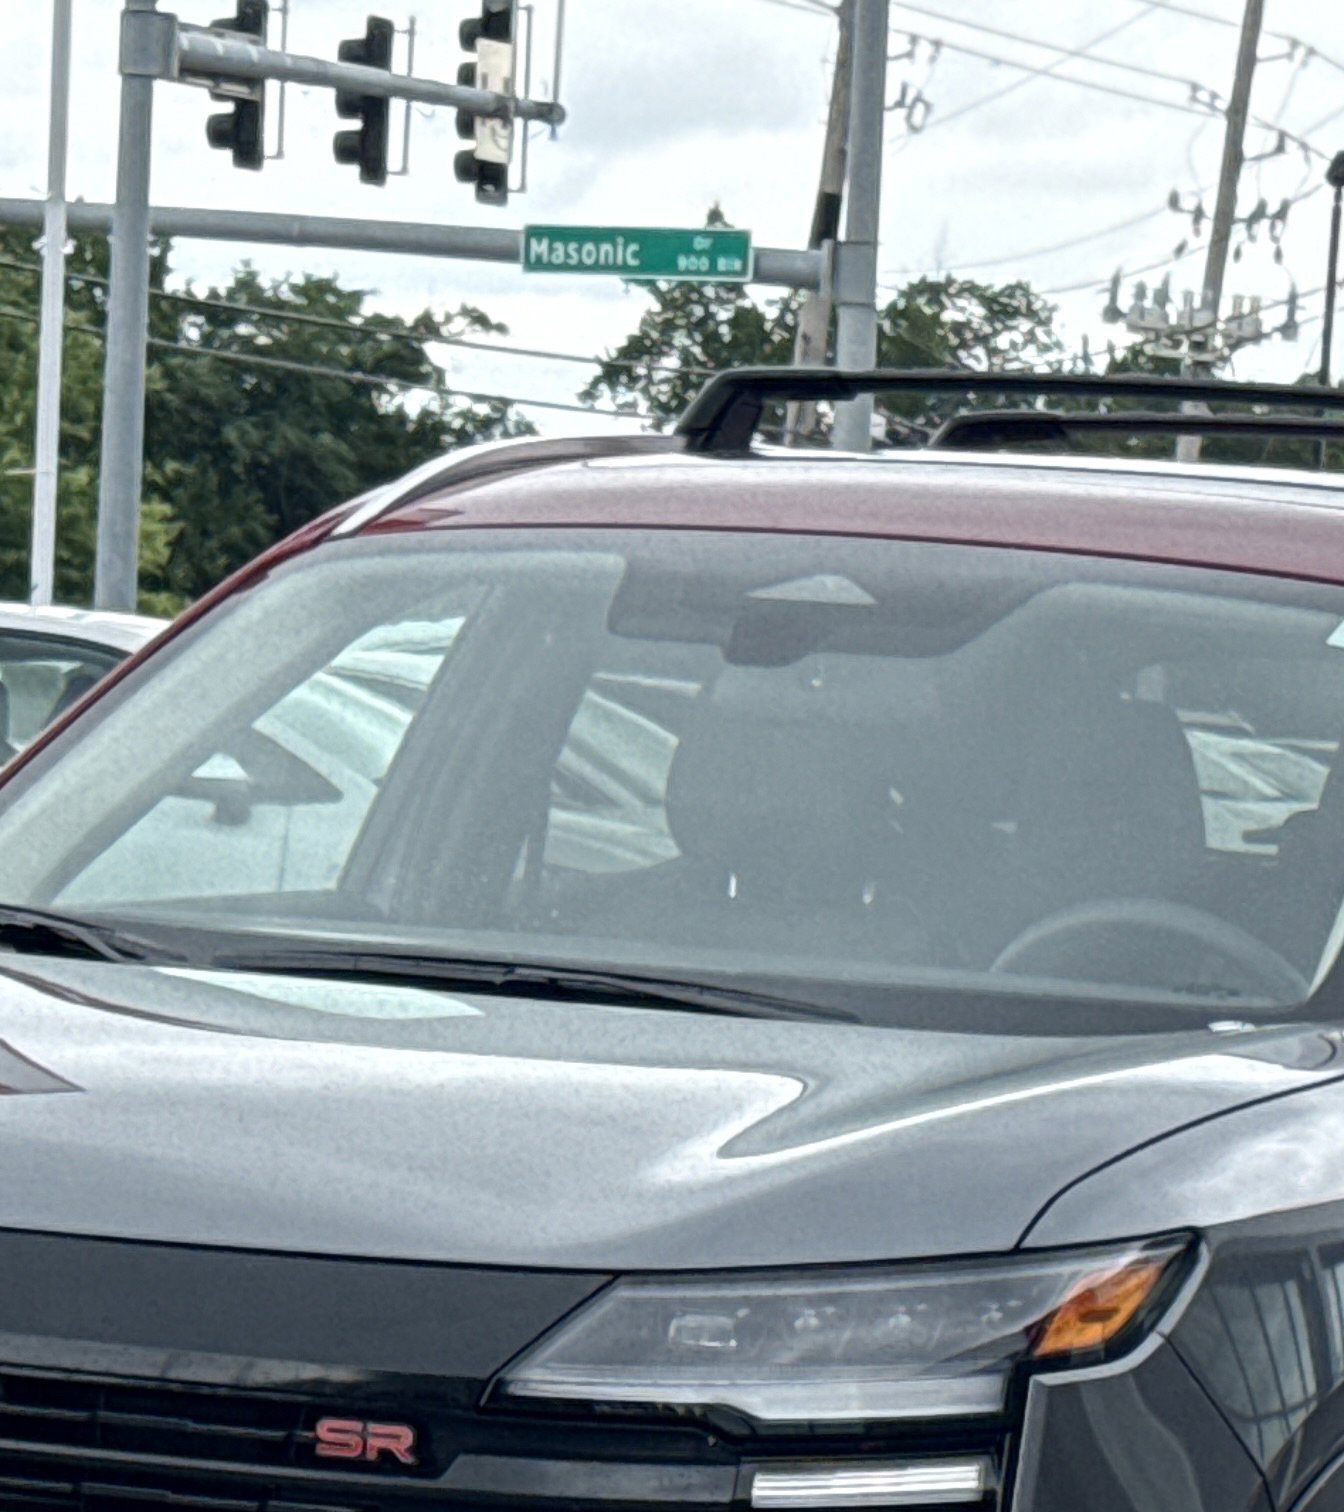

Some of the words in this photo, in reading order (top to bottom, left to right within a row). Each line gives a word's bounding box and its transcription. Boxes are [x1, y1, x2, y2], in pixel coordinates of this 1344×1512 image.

[529, 236, 641, 266] Masonic
[677, 254, 710, 272] 900
[314, 1415, 418, 1465] SR
